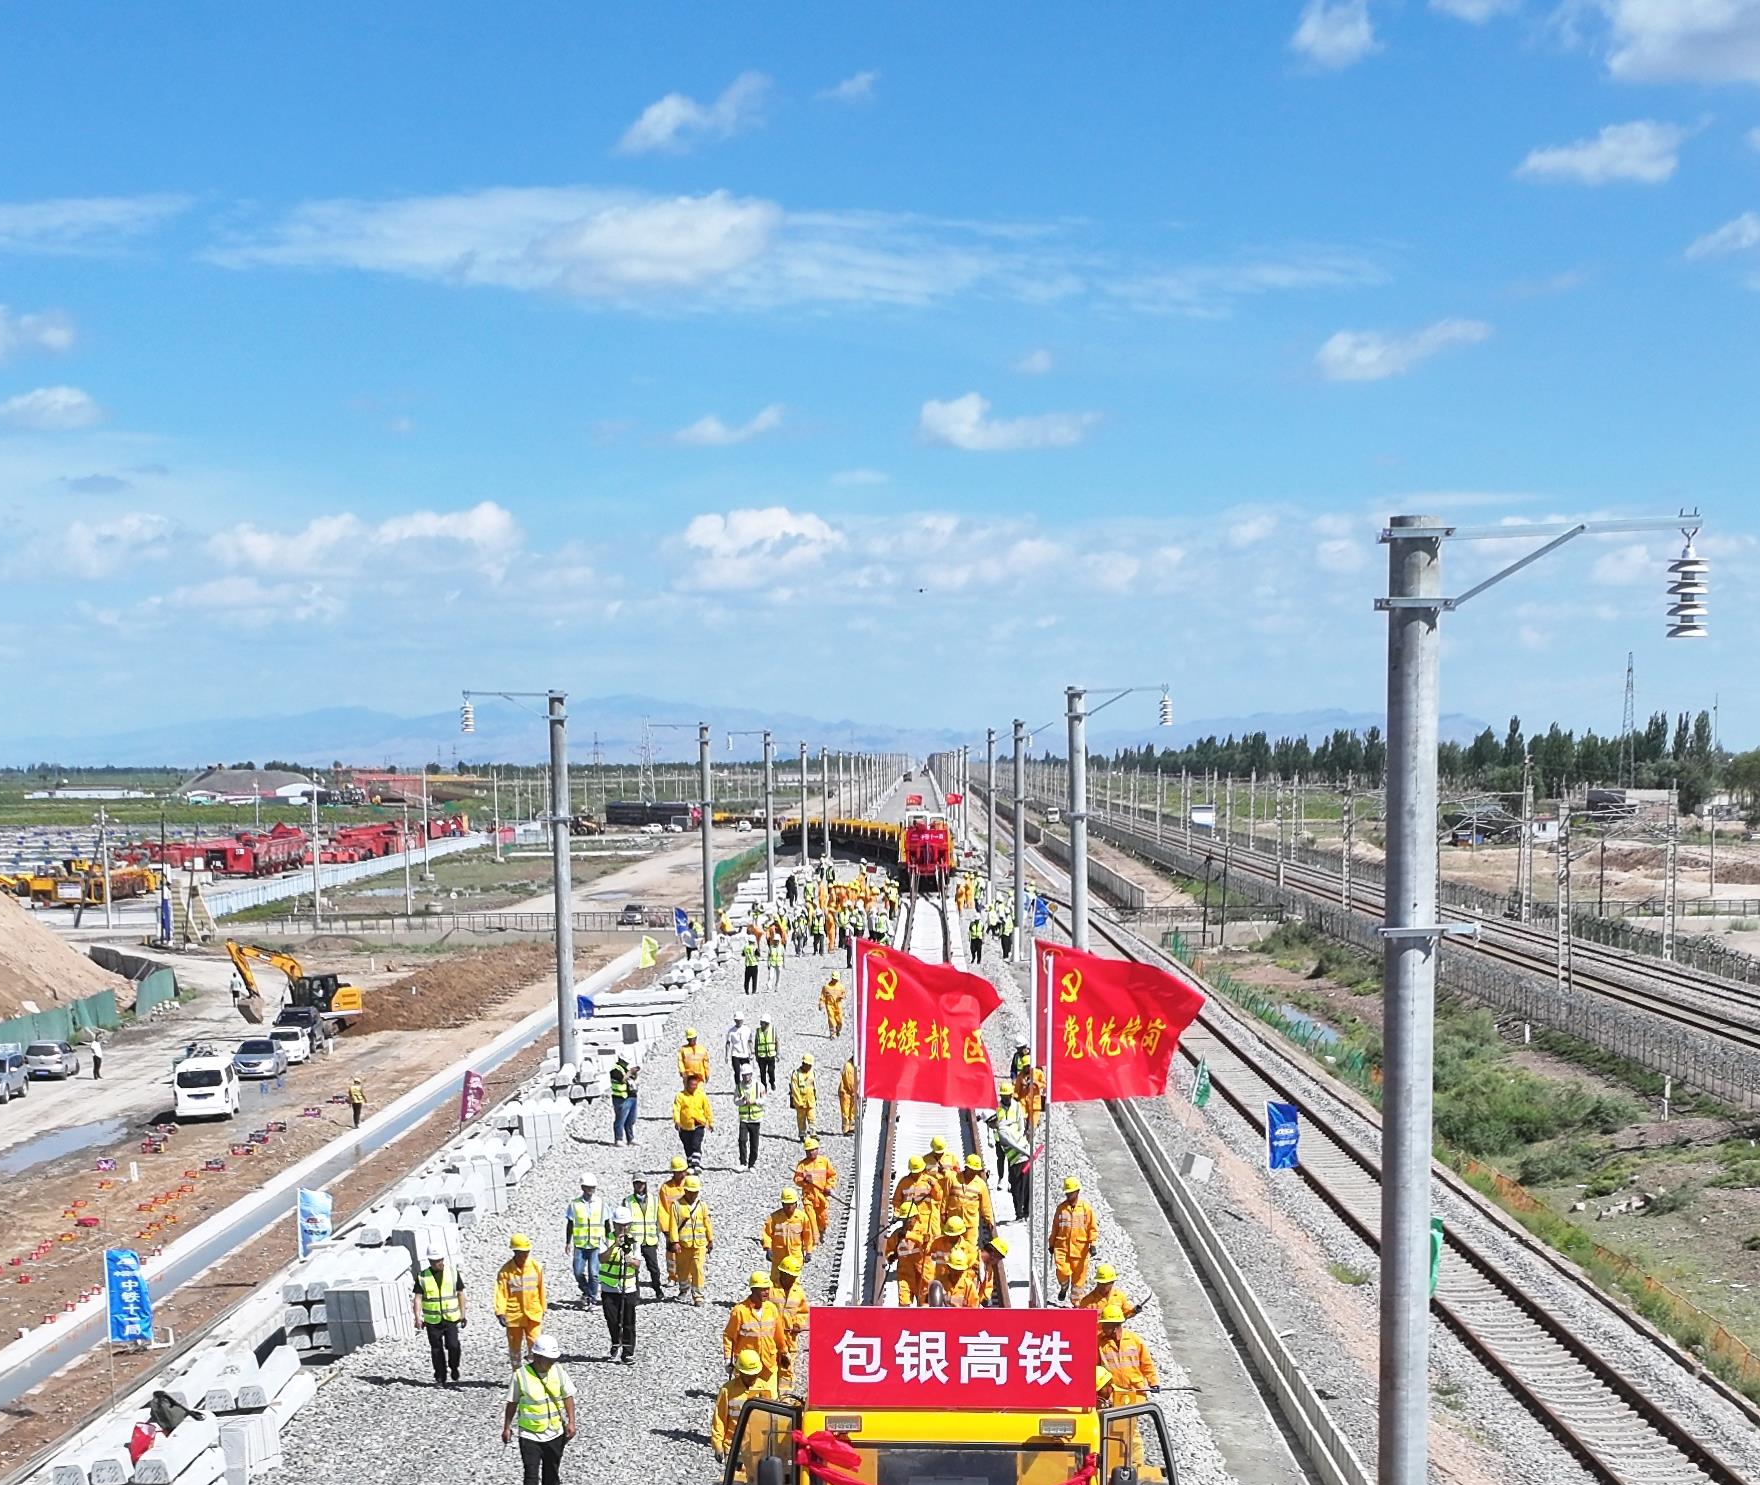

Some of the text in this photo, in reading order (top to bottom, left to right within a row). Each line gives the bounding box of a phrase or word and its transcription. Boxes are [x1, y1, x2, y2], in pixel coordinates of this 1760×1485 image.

[1063, 1015, 1167, 1059] 党员先锋岗
[121, 1280, 141, 1336] 中铁十一局
[833, 1330, 1074, 1386] 包银高铁
